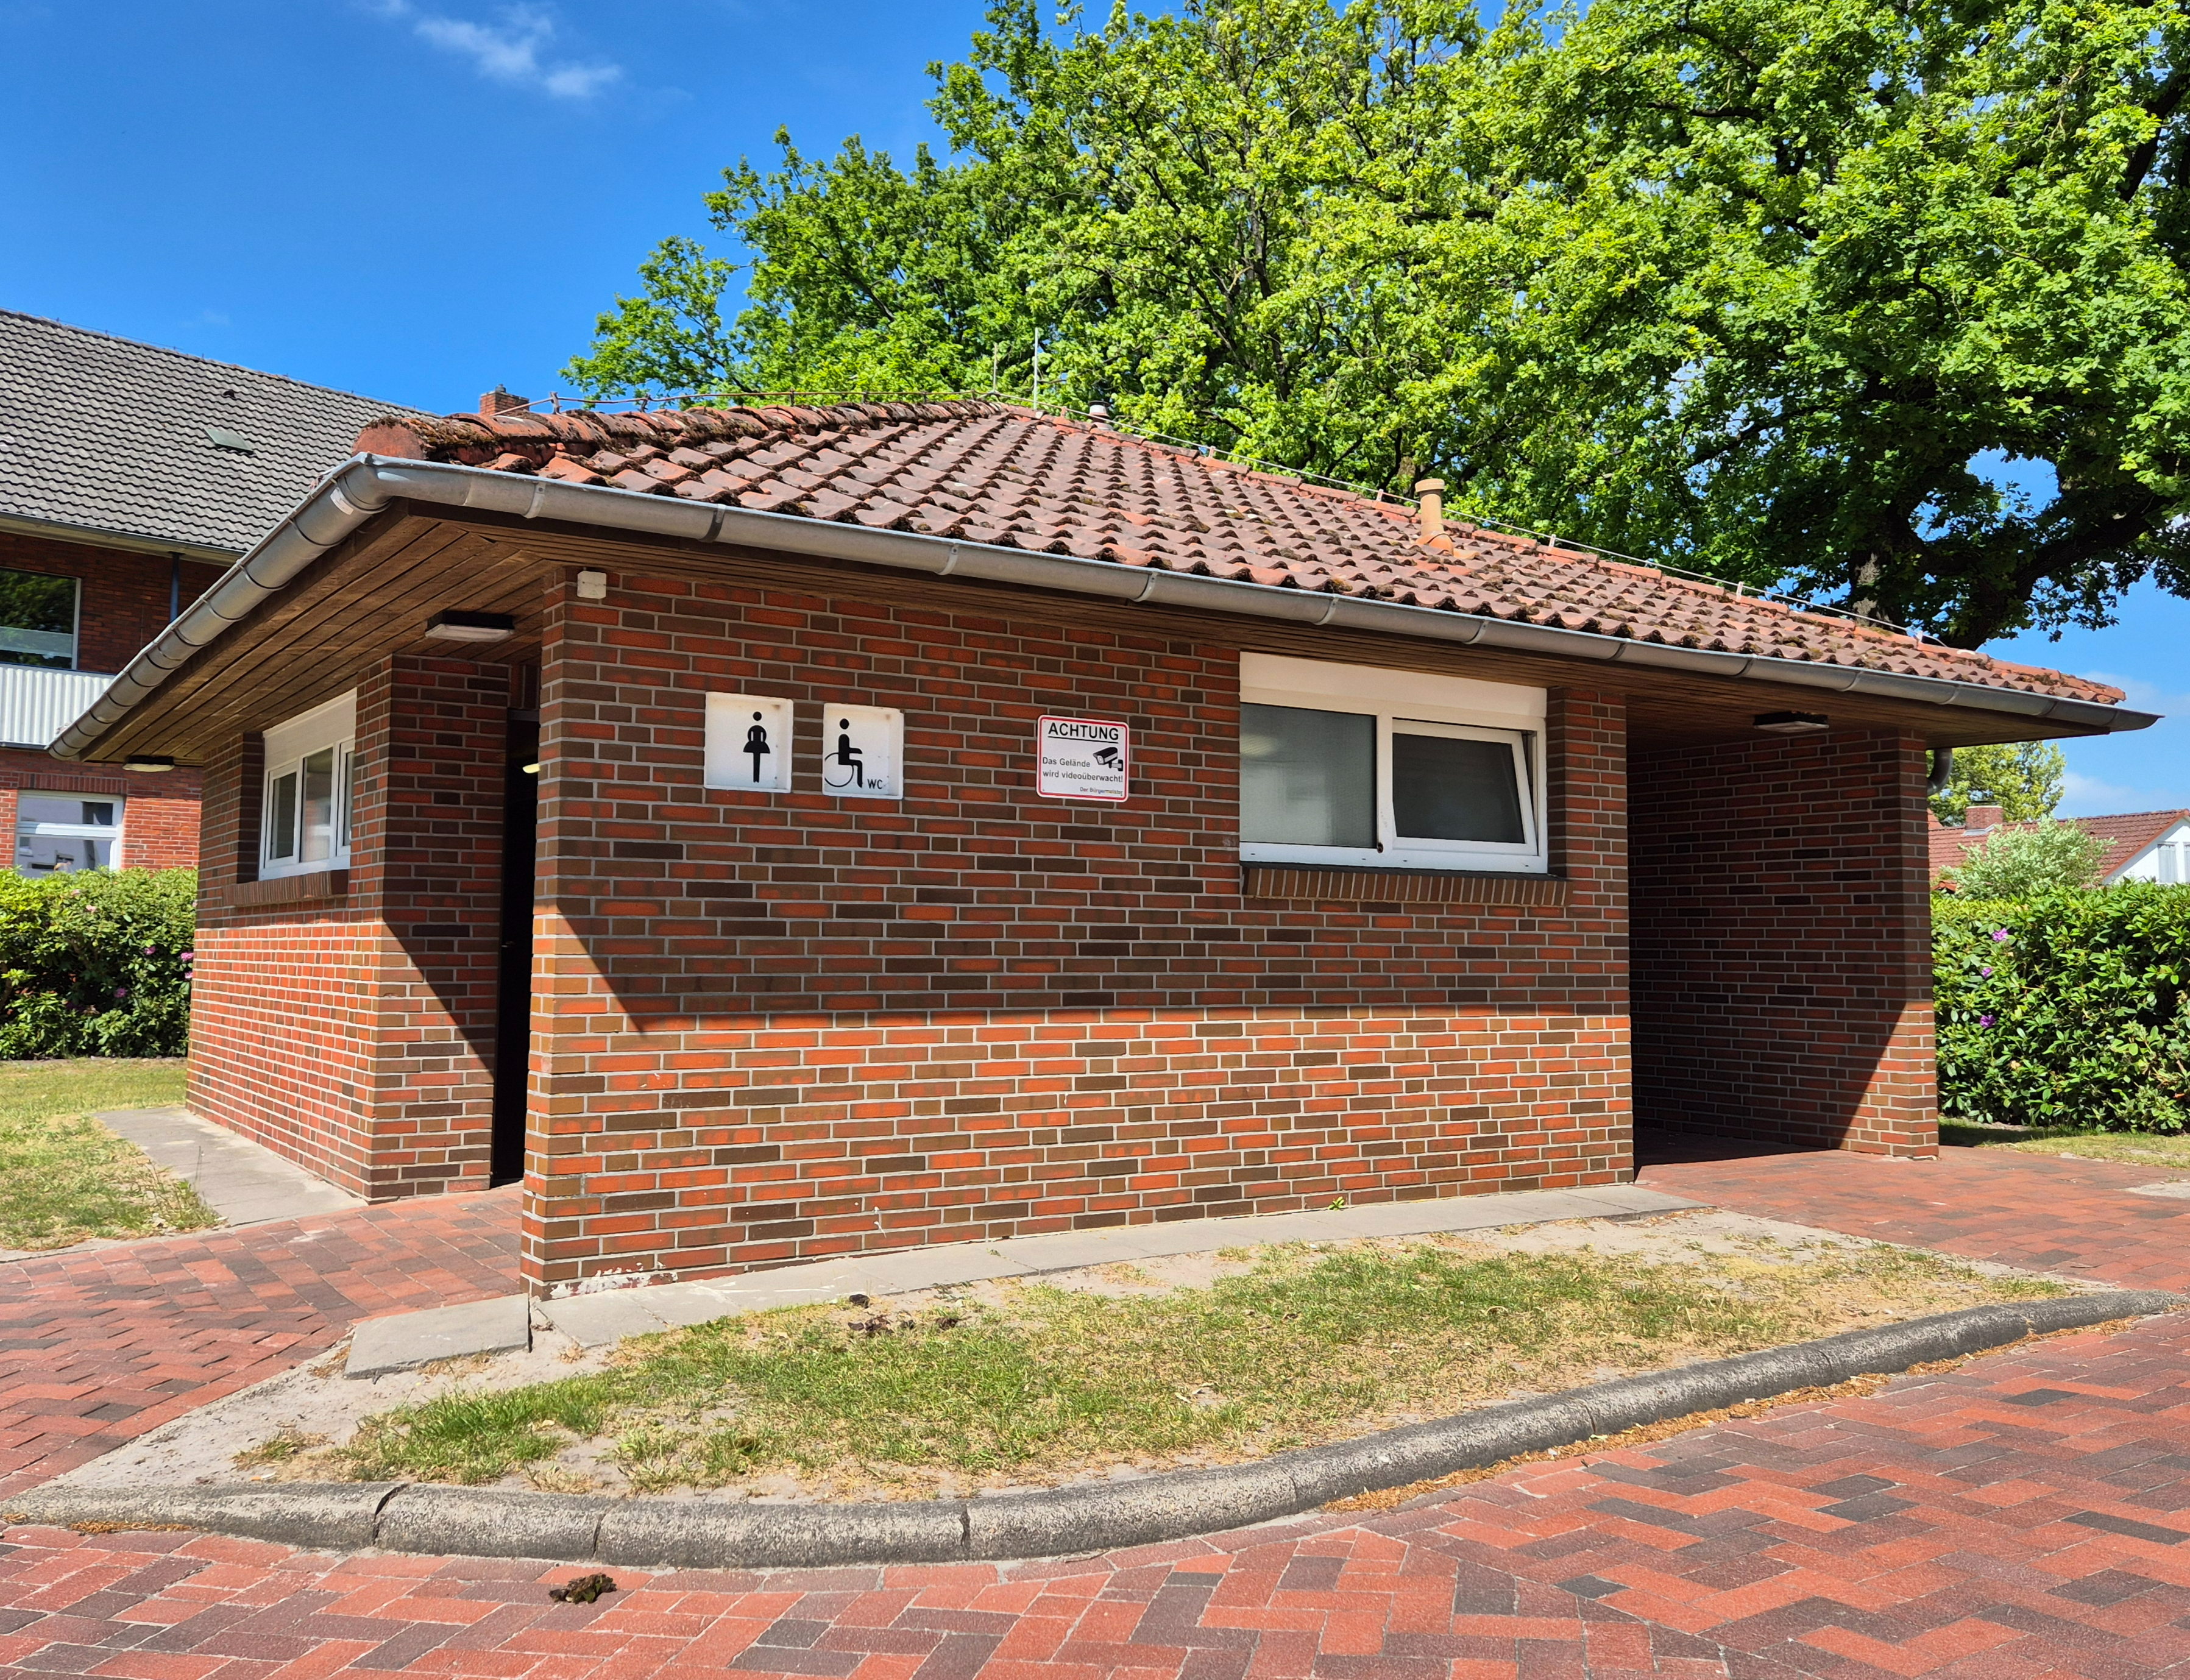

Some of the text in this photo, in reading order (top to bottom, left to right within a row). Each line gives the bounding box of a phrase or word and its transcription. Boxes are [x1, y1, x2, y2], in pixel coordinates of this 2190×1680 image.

[1048, 722, 1119, 740] ACHTUNG
[1060, 758, 1090, 767] Gelände
[1061, 771, 1123, 782] videoüberwacht!
[867, 778, 883, 790] WC
